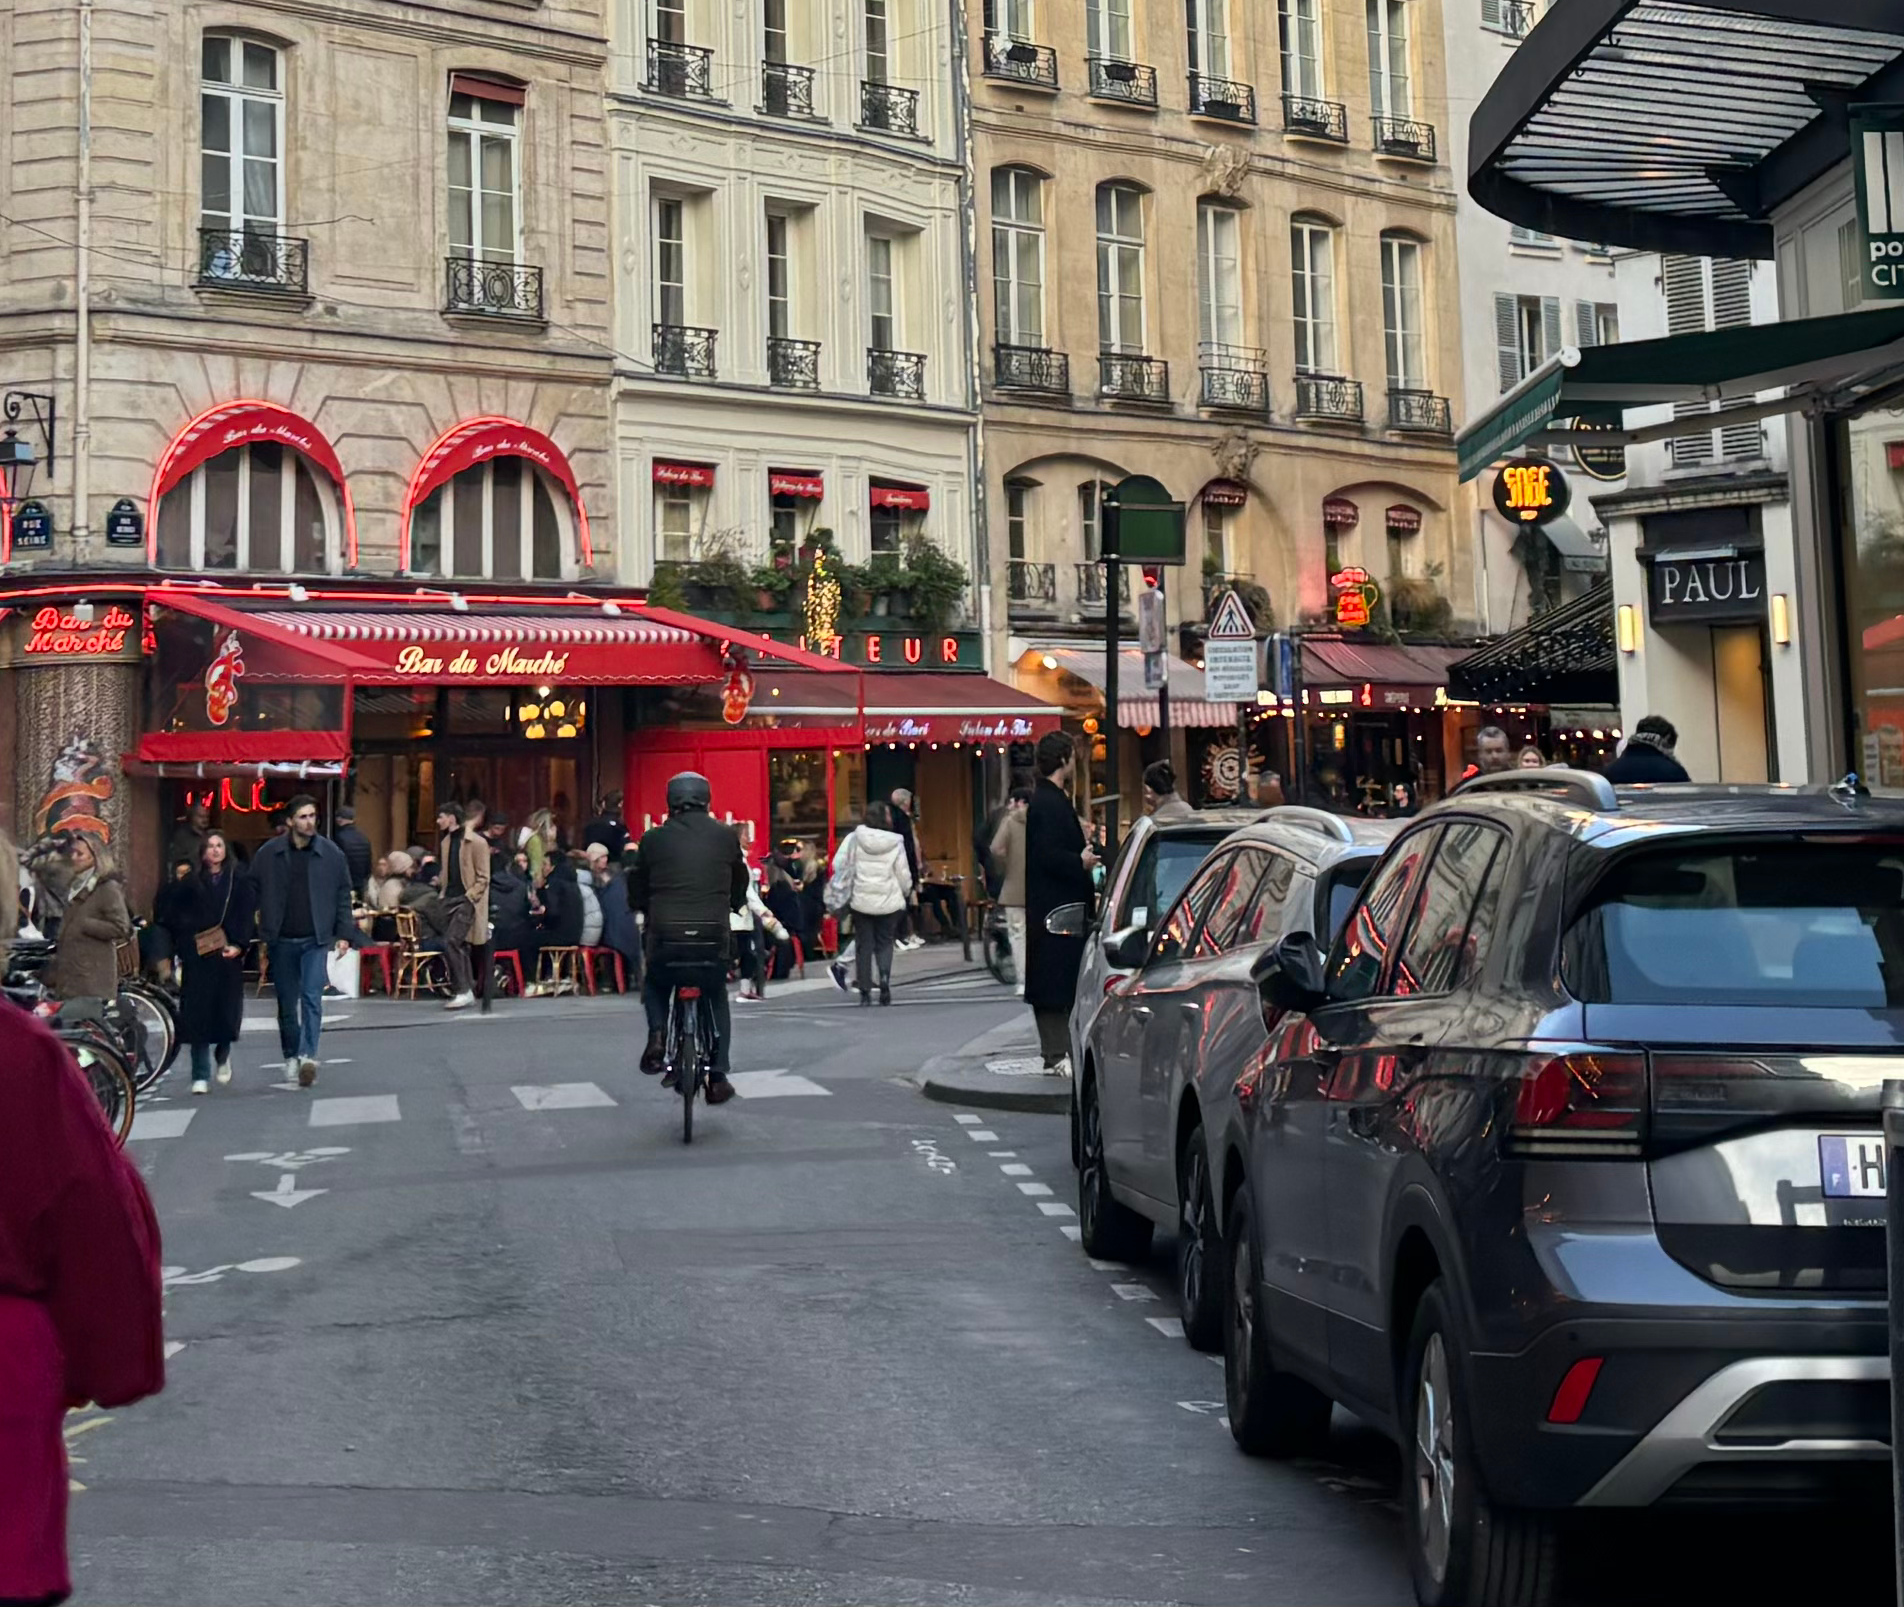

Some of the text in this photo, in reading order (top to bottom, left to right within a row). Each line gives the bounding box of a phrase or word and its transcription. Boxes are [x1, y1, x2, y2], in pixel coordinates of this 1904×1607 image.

[1662, 561, 1760, 604] PAUL
[31, 606, 134, 630] Bar du
[24, 628, 125, 652] Marché
[396, 646, 569, 674] Bar du Marché
